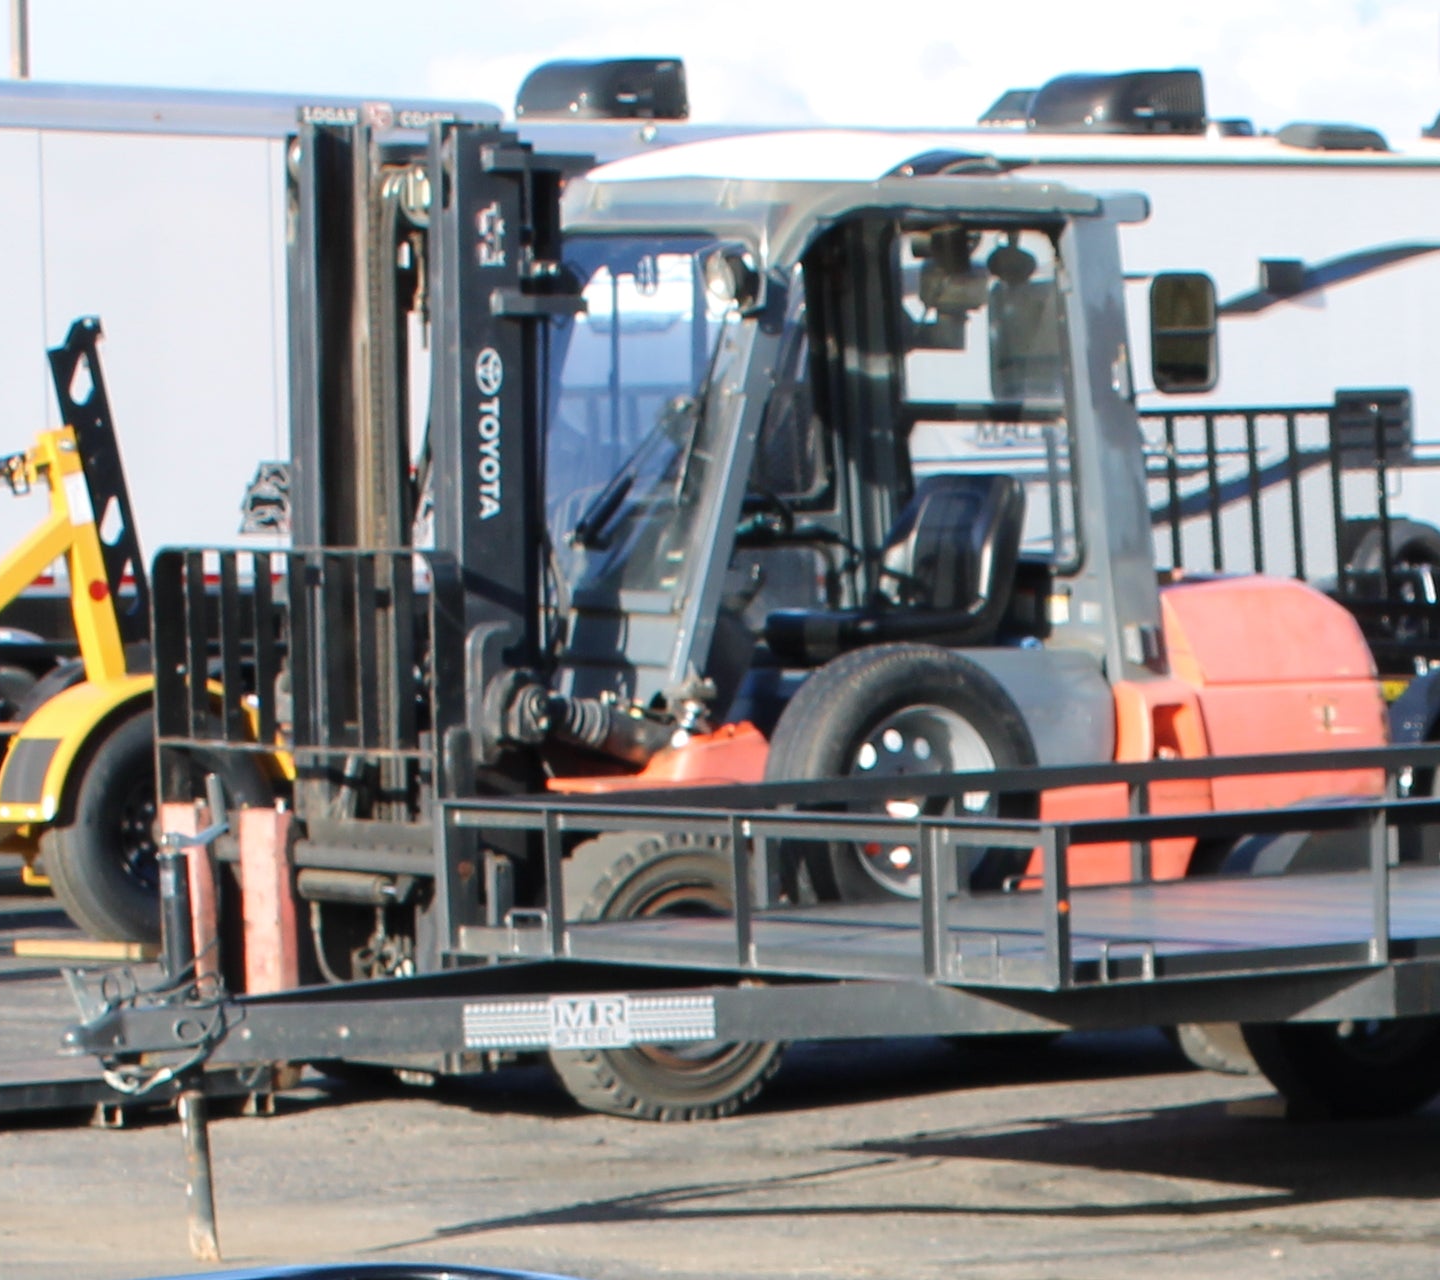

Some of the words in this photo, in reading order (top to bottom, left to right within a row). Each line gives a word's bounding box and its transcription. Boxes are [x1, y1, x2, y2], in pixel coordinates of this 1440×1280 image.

[302, 106, 358, 125] LOGAN
[478, 397, 502, 521] TOYOTA
[553, 1000, 625, 1027] MR
[555, 1027, 626, 1043] STEEL
